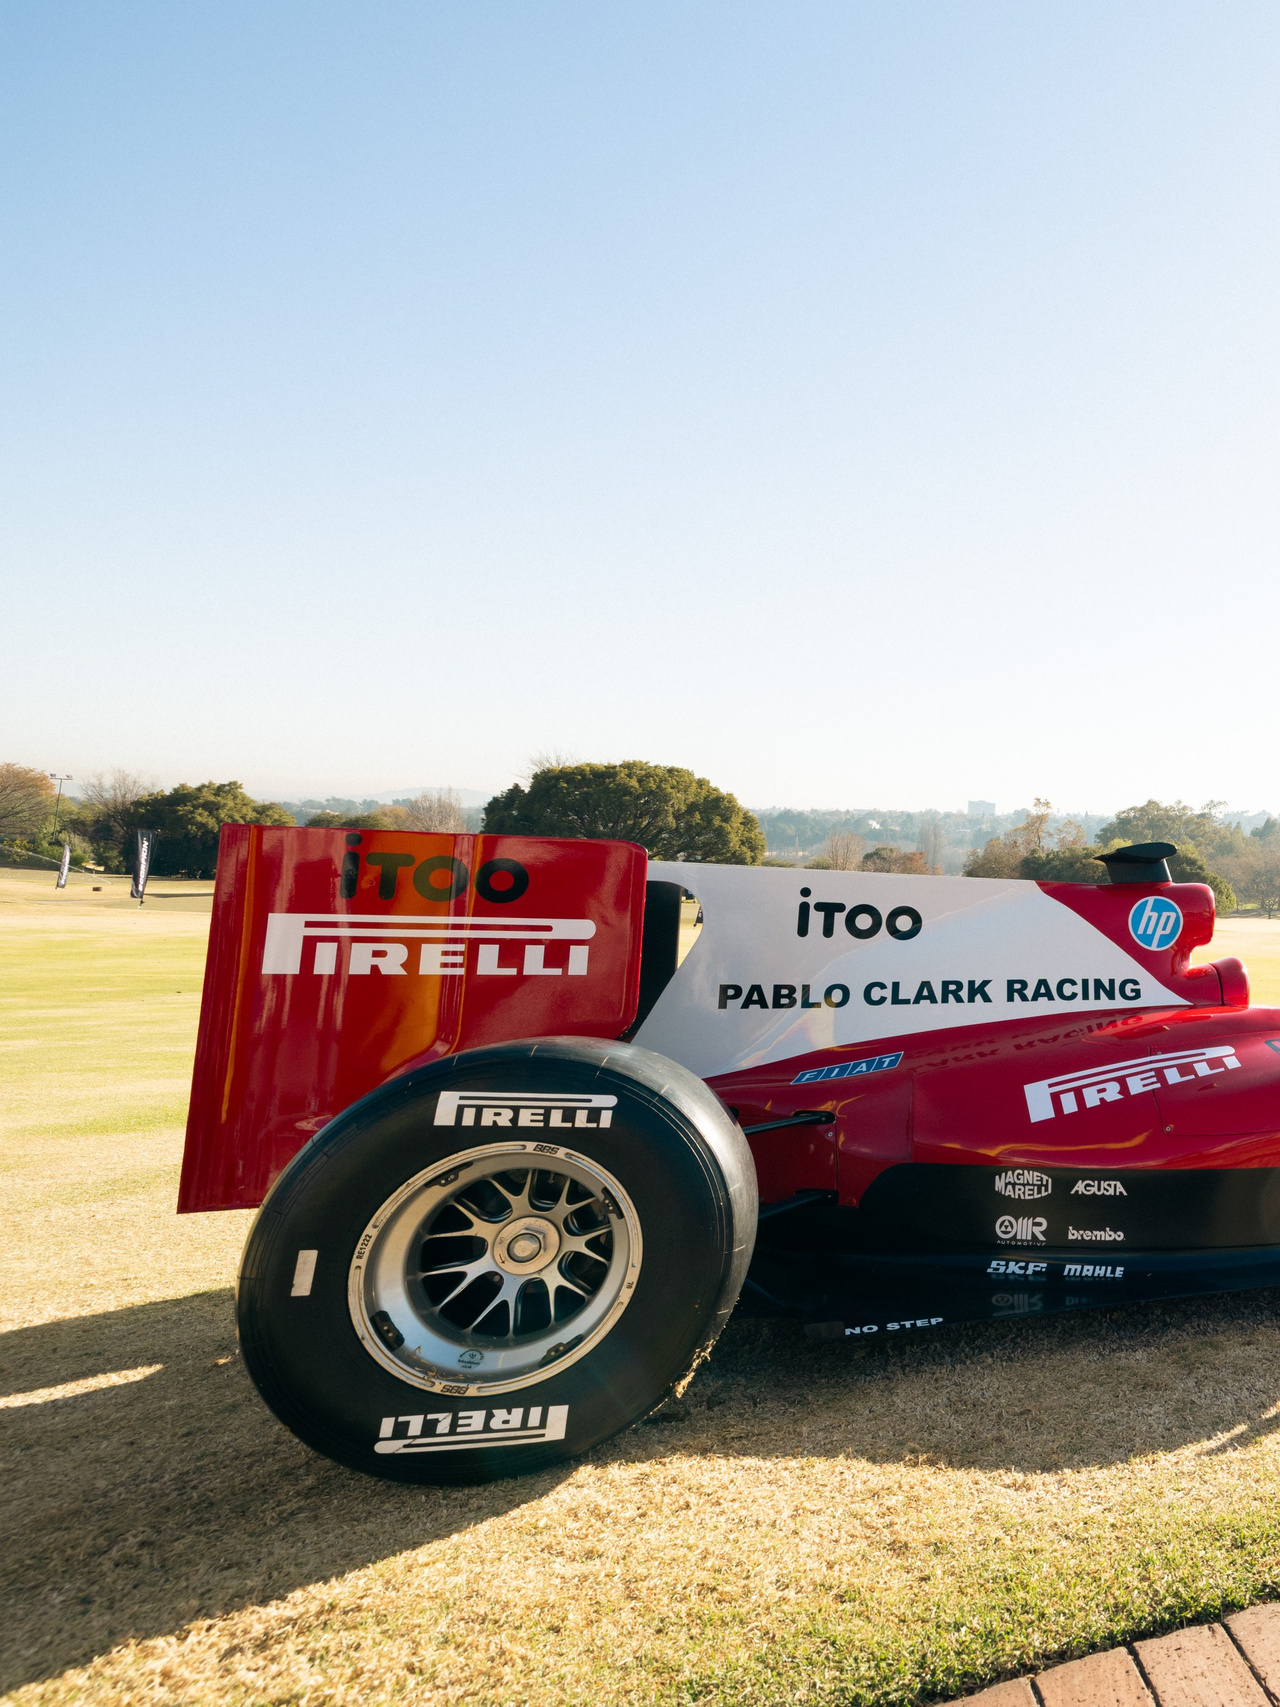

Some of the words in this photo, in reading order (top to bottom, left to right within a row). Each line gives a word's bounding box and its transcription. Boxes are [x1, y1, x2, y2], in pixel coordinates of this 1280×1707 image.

[138, 840, 148, 892] SCORPION
[1136, 898, 1177, 948] hp
[262, 913, 596, 975] PIRELLI
[718, 983, 850, 1010] PABLO
[864, 980, 992, 1006] CLARK
[1006, 976, 1142, 1002] RACING
[801, 1057, 895, 1082] FIAT
[1024, 1046, 1241, 1122] PIRELLI
[434, 1091, 617, 1128] PIRELLI
[533, 1144, 560, 1155] BBS
[995, 1170, 1052, 1190] MAGNETI
[995, 1180, 1052, 1200] MARELLI
[1070, 1180, 1128, 1196] AGUSTA
[1067, 1226, 1124, 1241] brembo
[356, 1233, 372, 1260] RE1222
[987, 1260, 1047, 1275] SKF
[1063, 1264, 1125, 1278] MAHLE
[845, 1325, 879, 1336] NO
[886, 1317, 944, 1331] STEP
[373, 1404, 569, 1454] PIRELLI
